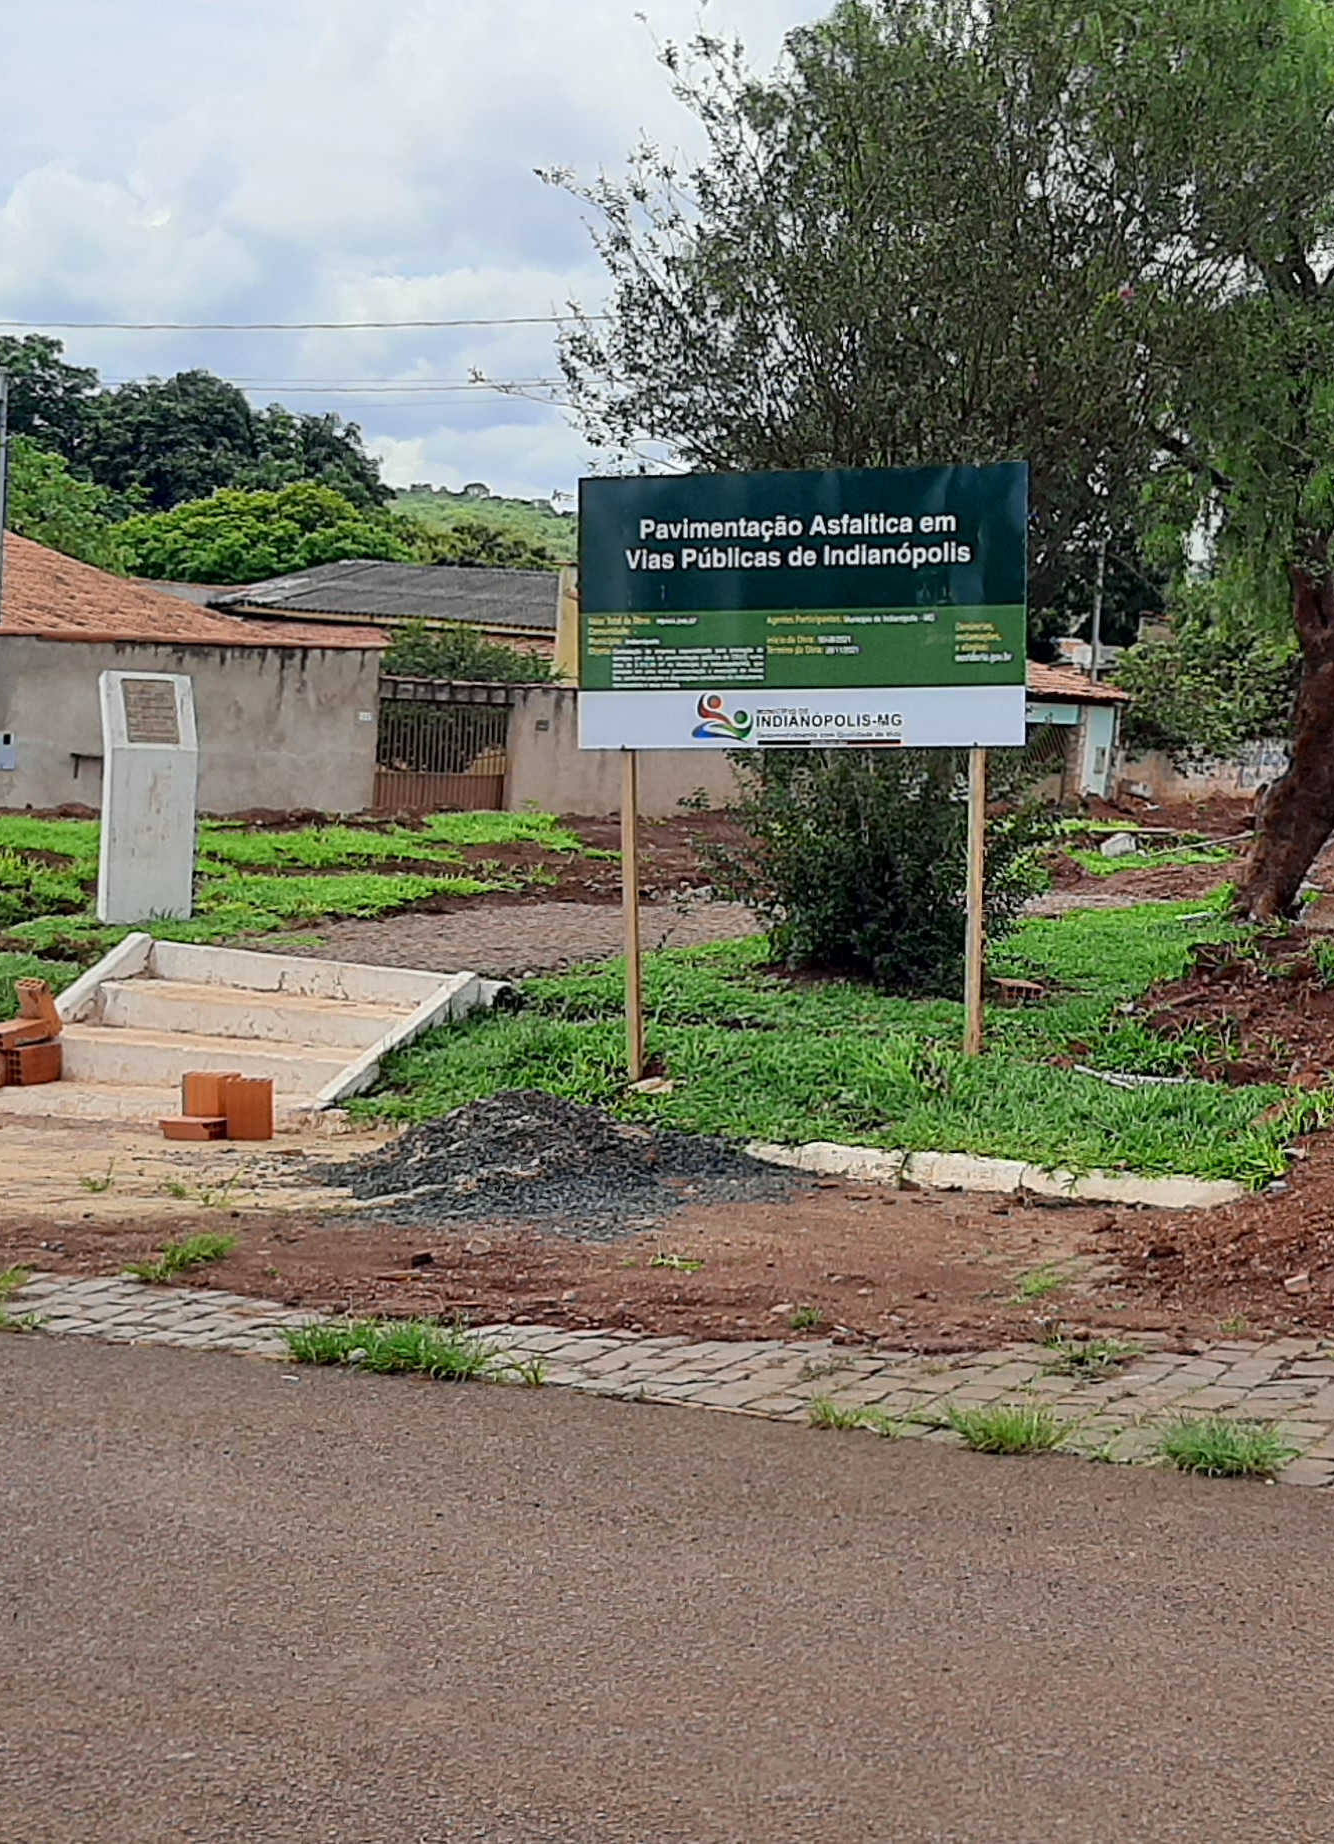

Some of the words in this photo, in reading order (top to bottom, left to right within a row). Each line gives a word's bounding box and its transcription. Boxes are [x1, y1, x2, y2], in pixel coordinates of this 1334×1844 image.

[639, 514, 804, 543] Pavimentação
[809, 512, 914, 536] Asfaltica
[919, 514, 957, 532] em
[625, 547, 675, 570] Vias
[681, 545, 782, 569] Públicas
[787, 545, 817, 567] de
[823, 540, 972, 569] Indianópolis
[756, 711, 903, 728] INDIANÓPOLIS-MG
